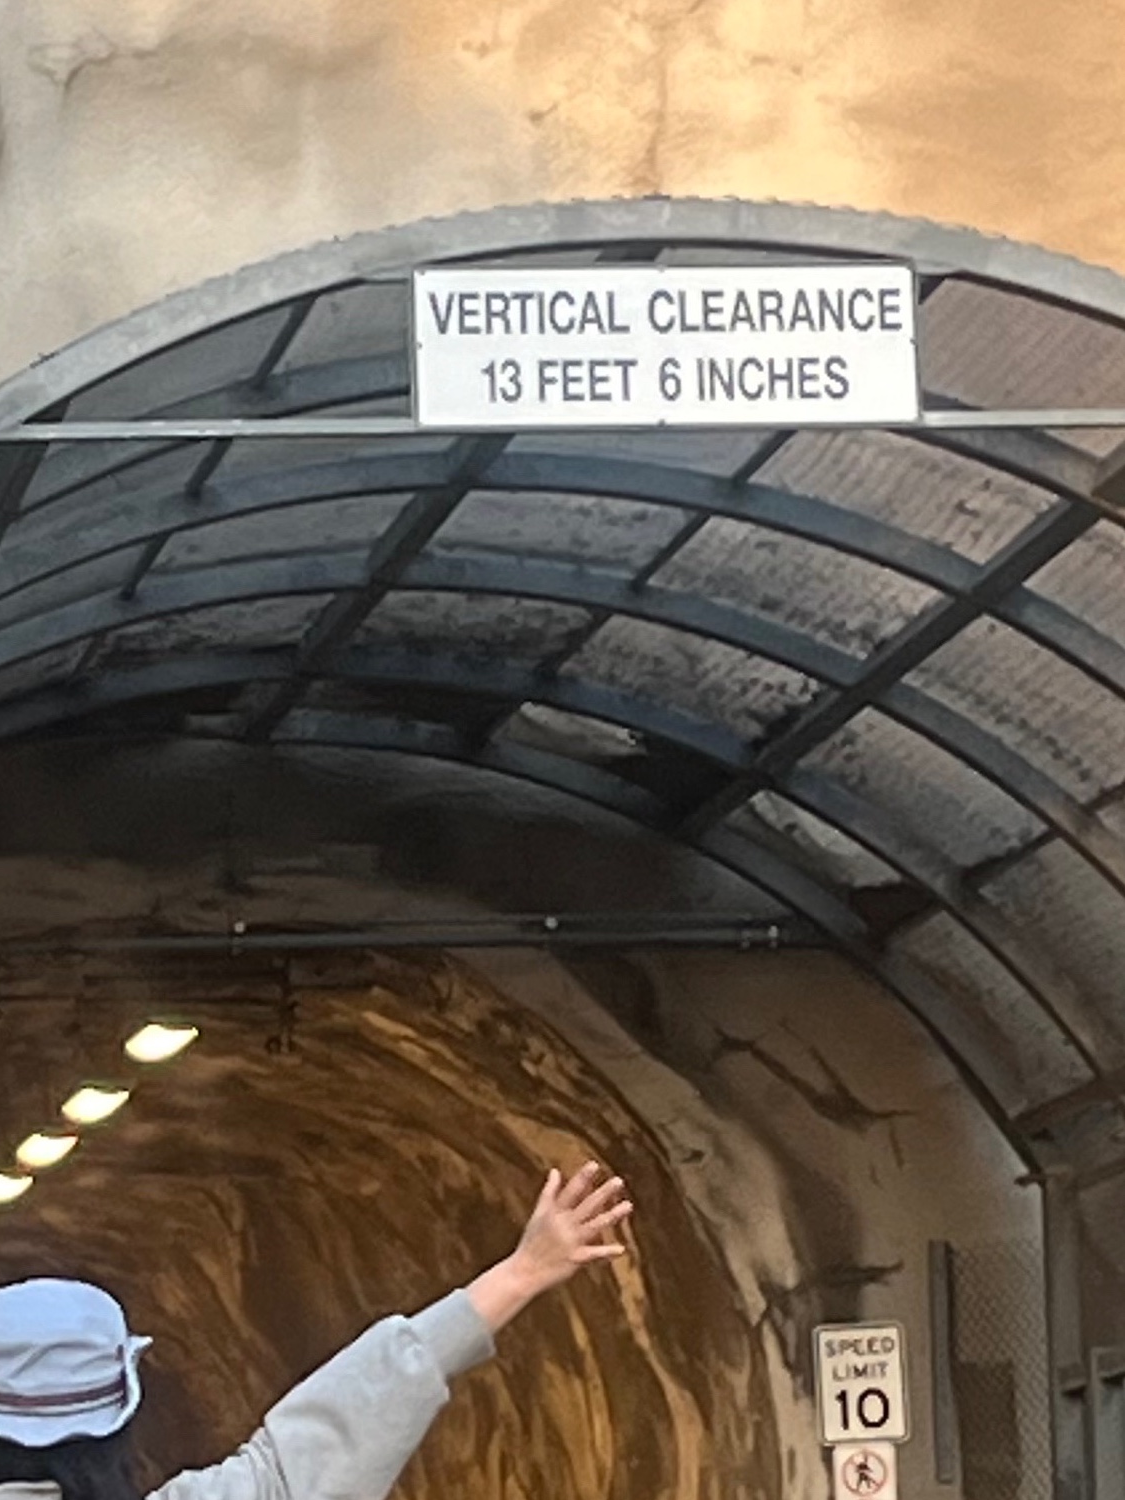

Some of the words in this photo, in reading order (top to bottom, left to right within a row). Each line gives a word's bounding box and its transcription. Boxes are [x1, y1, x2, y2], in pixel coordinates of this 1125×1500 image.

[428, 290, 631, 334] VERTICAL
[648, 287, 903, 333] CLEARANCE
[481, 359, 522, 402] 13
[538, 358, 638, 401] FEET
[659, 357, 683, 401] 6
[697, 356, 851, 400] INCHES
[825, 1336, 895, 1358] SPEED
[833, 1362, 889, 1382] LIMIT
[835, 1387, 890, 1430] 10
